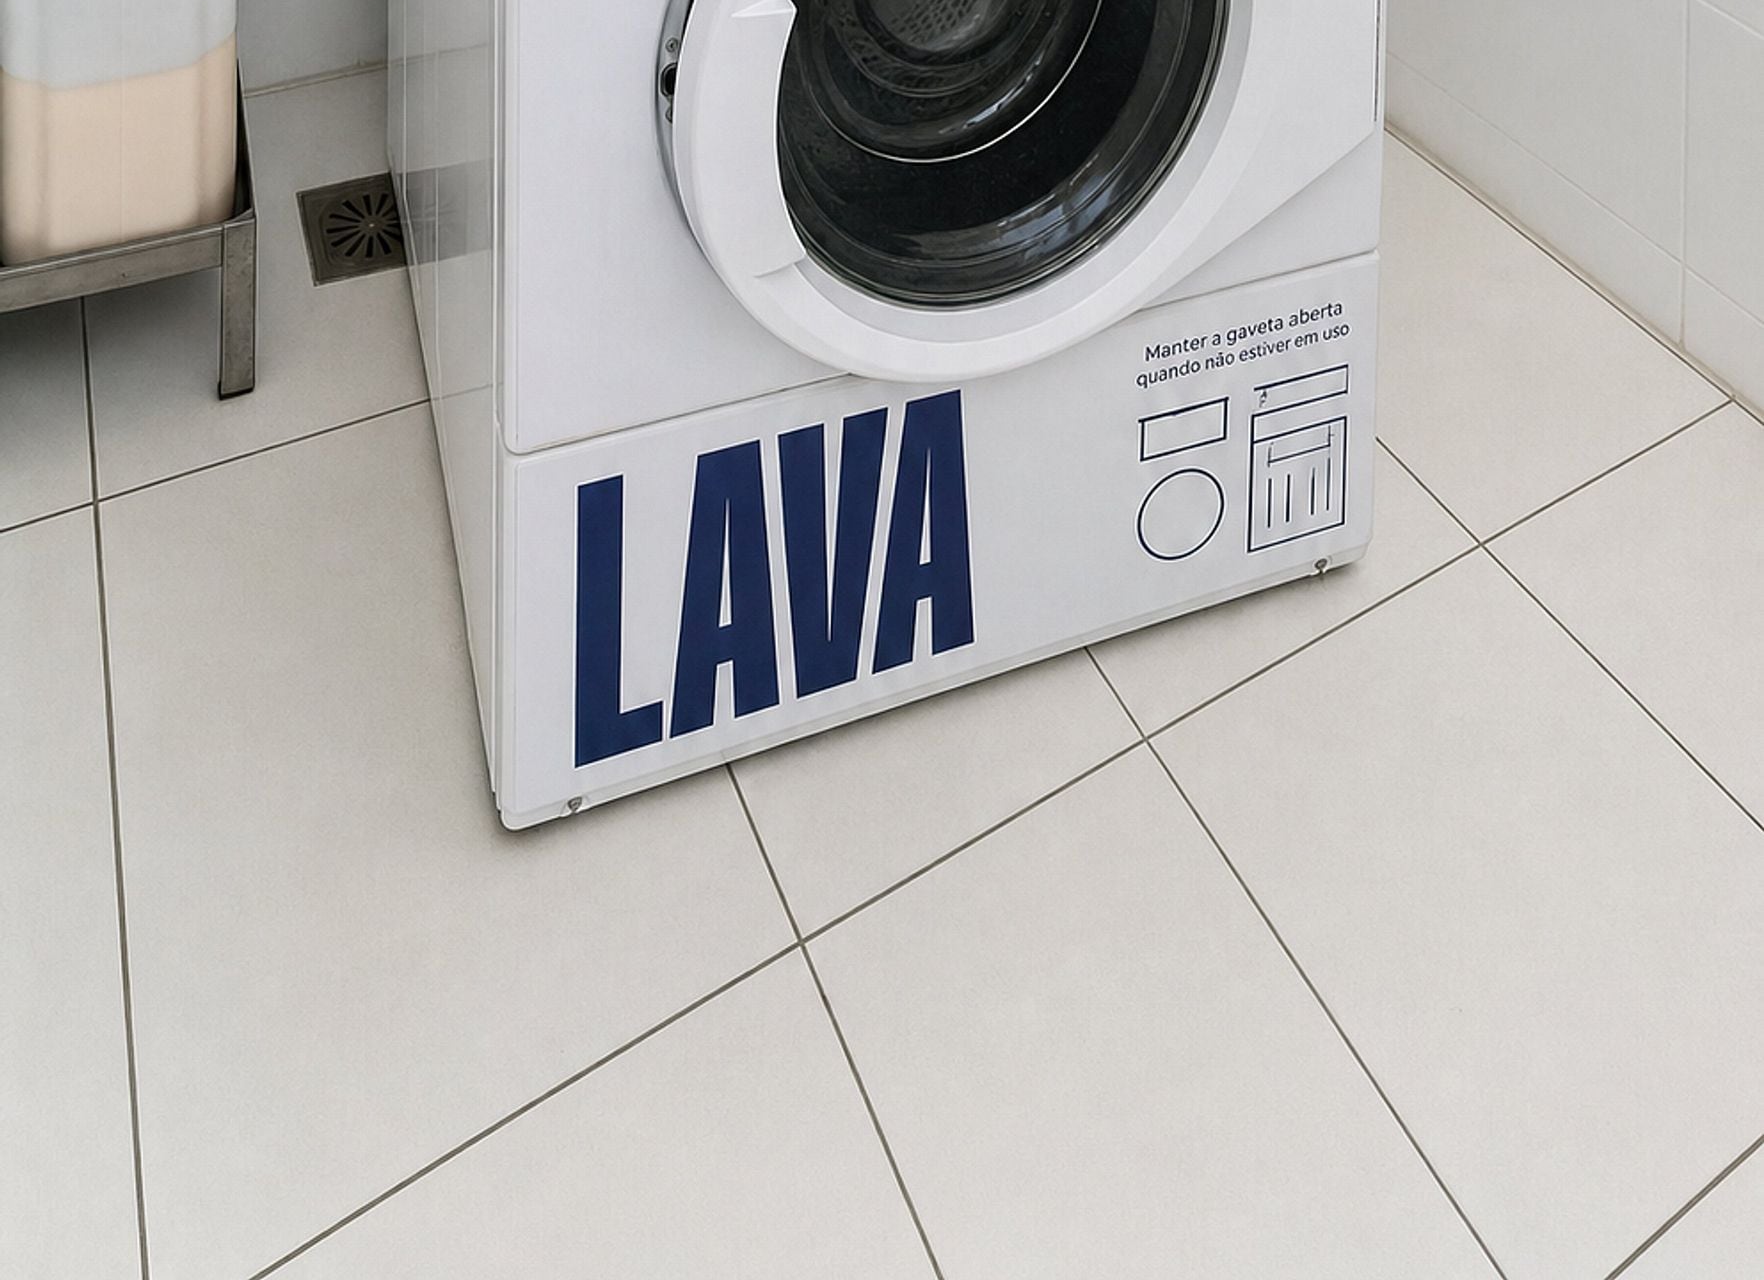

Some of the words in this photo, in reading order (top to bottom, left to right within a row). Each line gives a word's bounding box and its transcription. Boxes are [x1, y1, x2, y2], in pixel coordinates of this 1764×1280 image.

[1135, 361, 1202, 389] quando
[1204, 351, 1236, 371] não
[1238, 338, 1293, 363] estiver
[1294, 331, 1320, 347] em
[1321, 322, 1351, 340] uso
[1144, 334, 1209, 362] Manter
[1211, 333, 1222, 346] a
[1226, 317, 1284, 346] gaveta
[1288, 302, 1344, 327] aberta
[574, 389, 976, 768] LAVA
